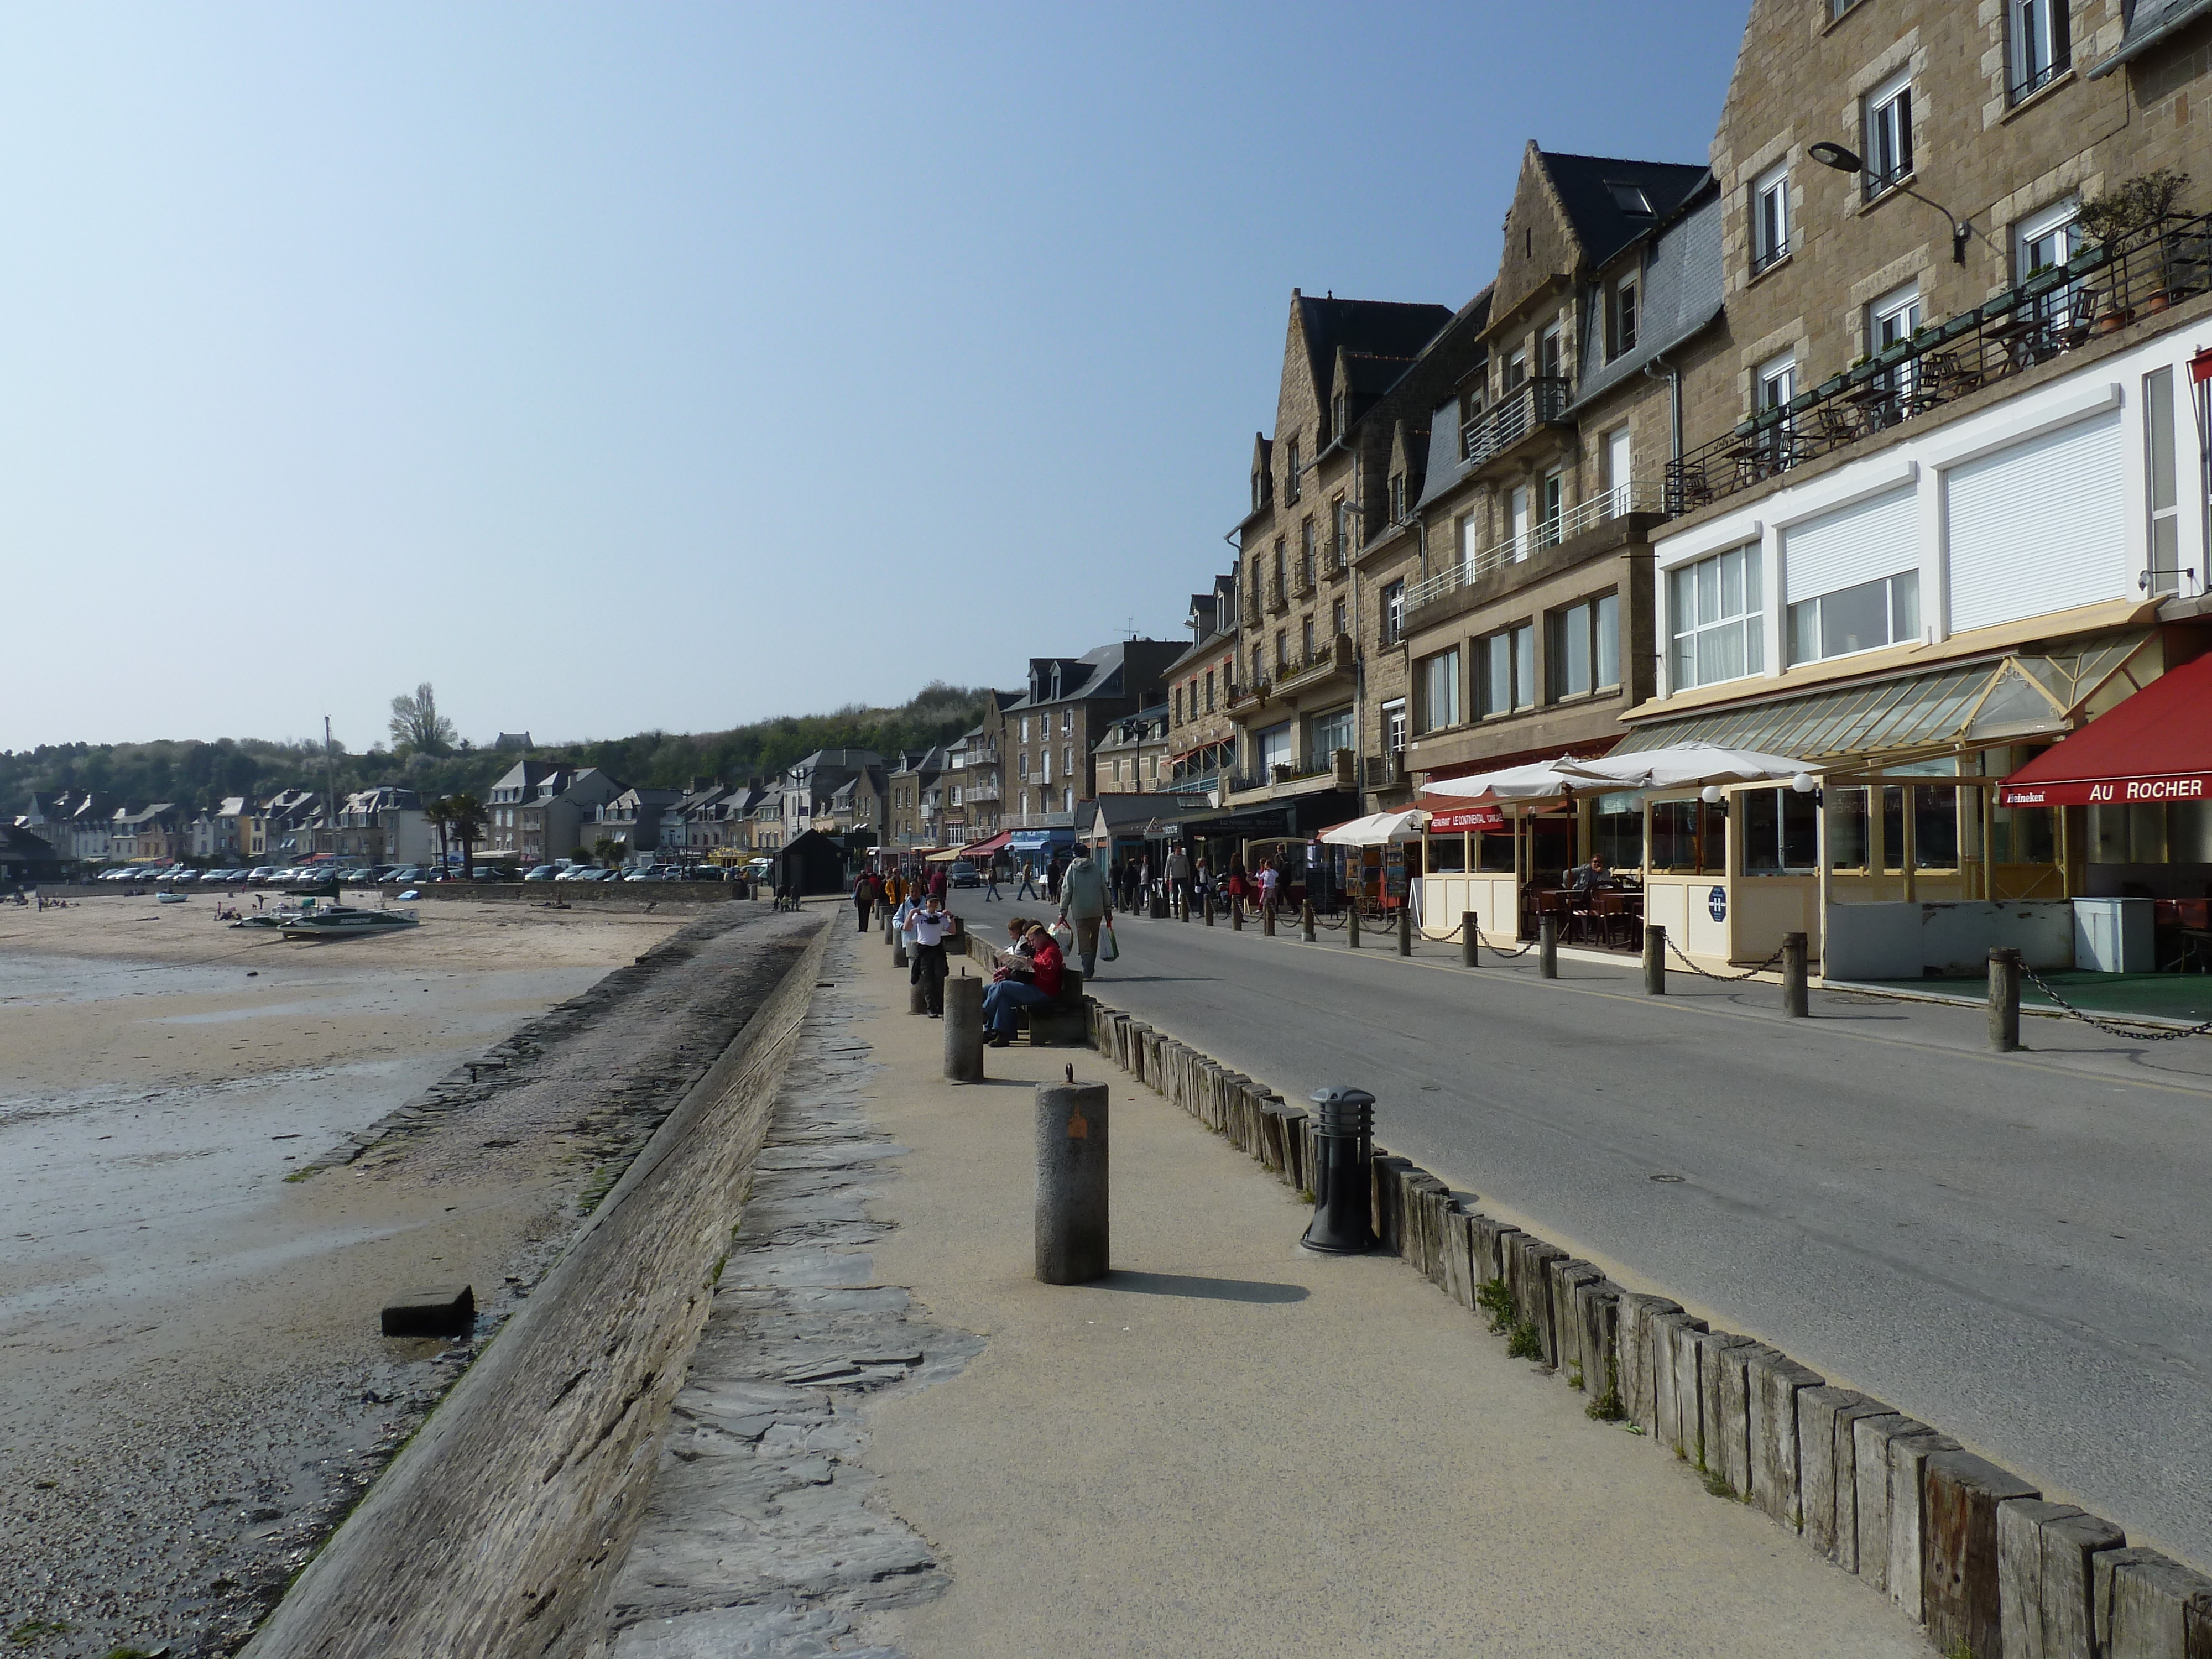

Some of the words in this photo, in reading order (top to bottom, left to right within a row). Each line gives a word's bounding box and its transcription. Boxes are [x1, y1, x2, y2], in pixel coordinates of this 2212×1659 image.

[2089, 784, 2114, 800] AU
[2126, 779, 2203, 799] ROCHER
[2007, 792, 2045, 804] Heineken
[1459, 813, 1486, 825] CONTINENTAL
[1714, 897, 1721, 912] H
